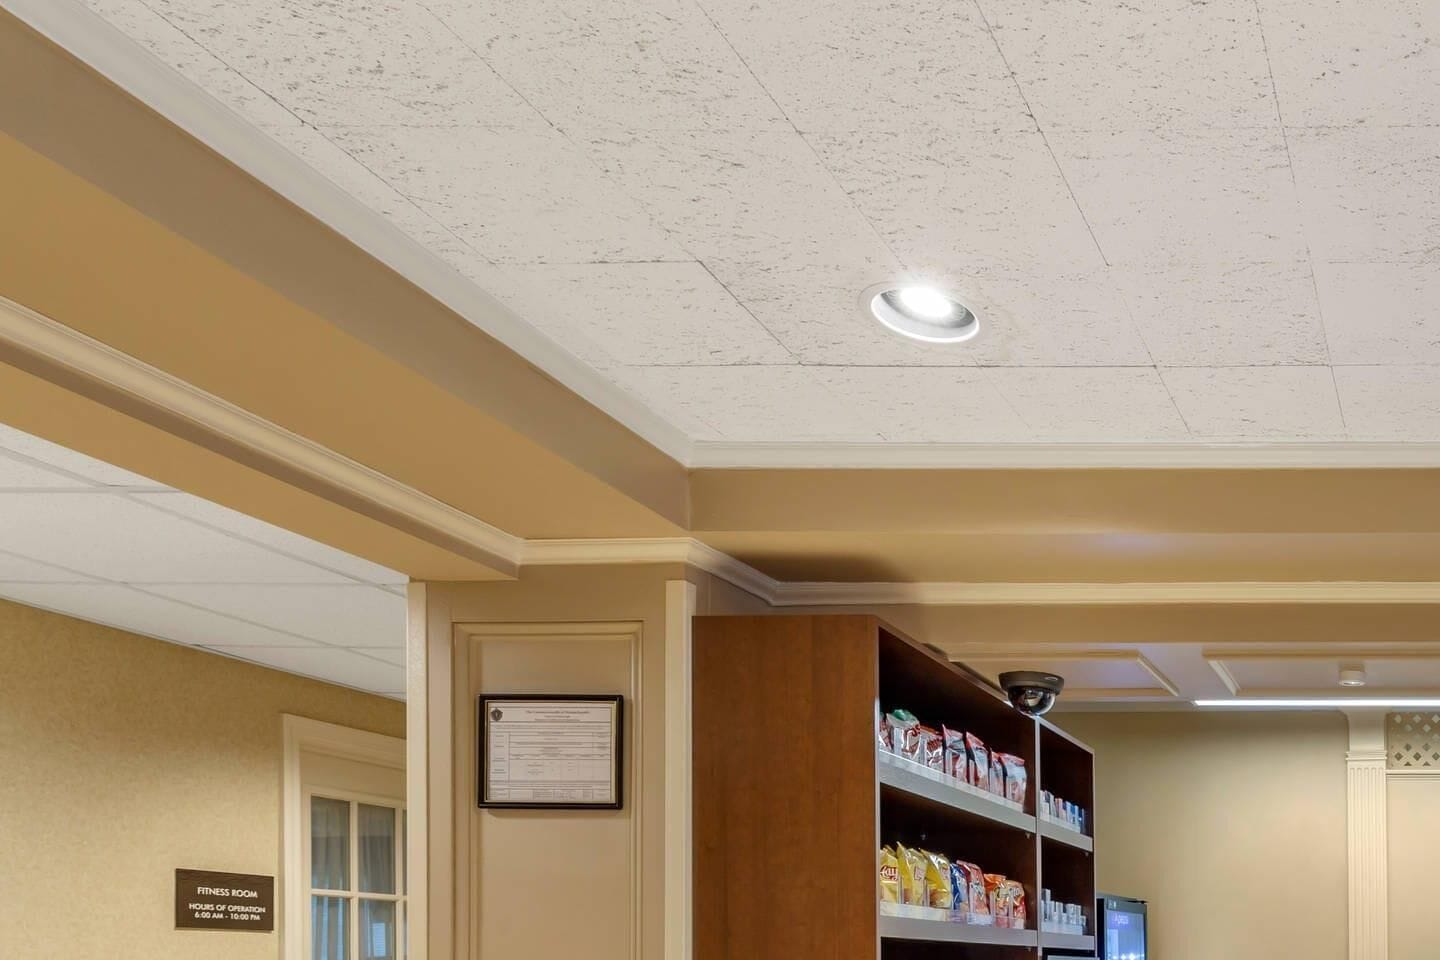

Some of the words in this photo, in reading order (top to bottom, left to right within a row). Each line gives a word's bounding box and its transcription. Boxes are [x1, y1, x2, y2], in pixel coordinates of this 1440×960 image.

[197, 887, 230, 897] FITNESS
[231, 889, 258, 898] ROOM
[188, 903, 215, 911] HOURS
[227, 905, 266, 913] OPERATION
[194, 911, 211, 919] 6:00
